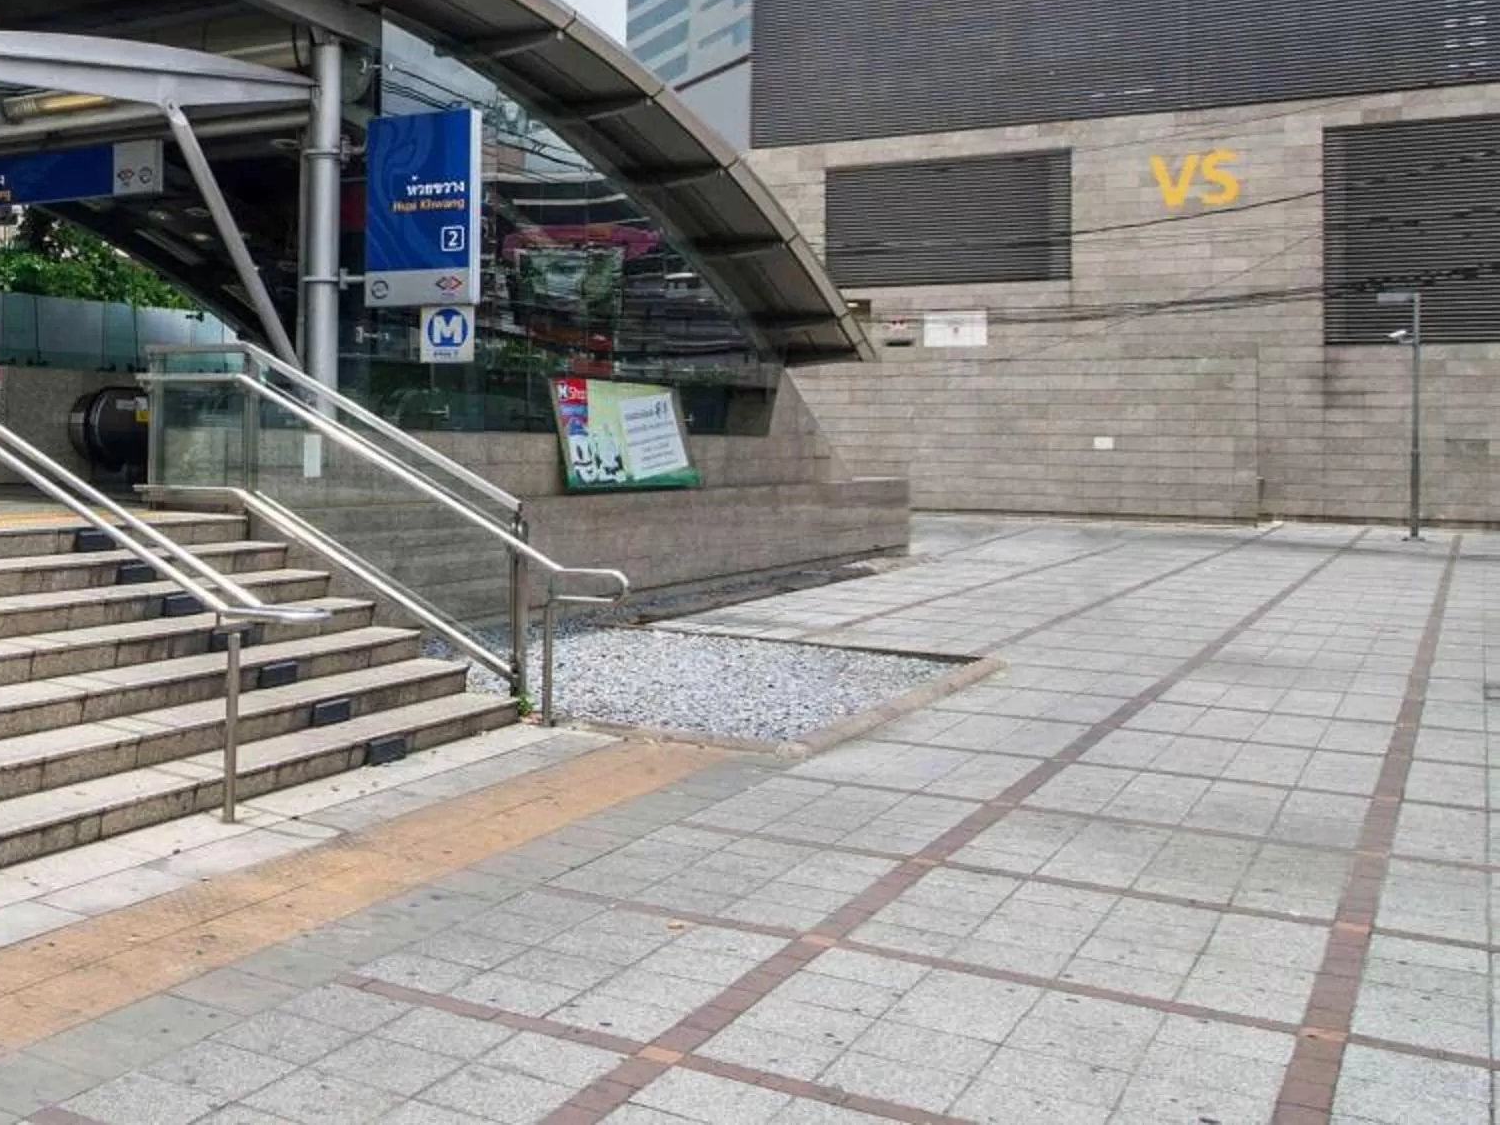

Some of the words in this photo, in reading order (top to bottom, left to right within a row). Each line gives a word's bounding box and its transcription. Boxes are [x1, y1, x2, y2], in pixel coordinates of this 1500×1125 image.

[406, 175, 465, 196] ห้วยขวาง
[1149, 147, 1238, 206] VS
[393, 201, 417, 212] Huai
[420, 198, 465, 211] Khwang
[447, 230, 459, 247] 2
[433, 314, 463, 344] M
